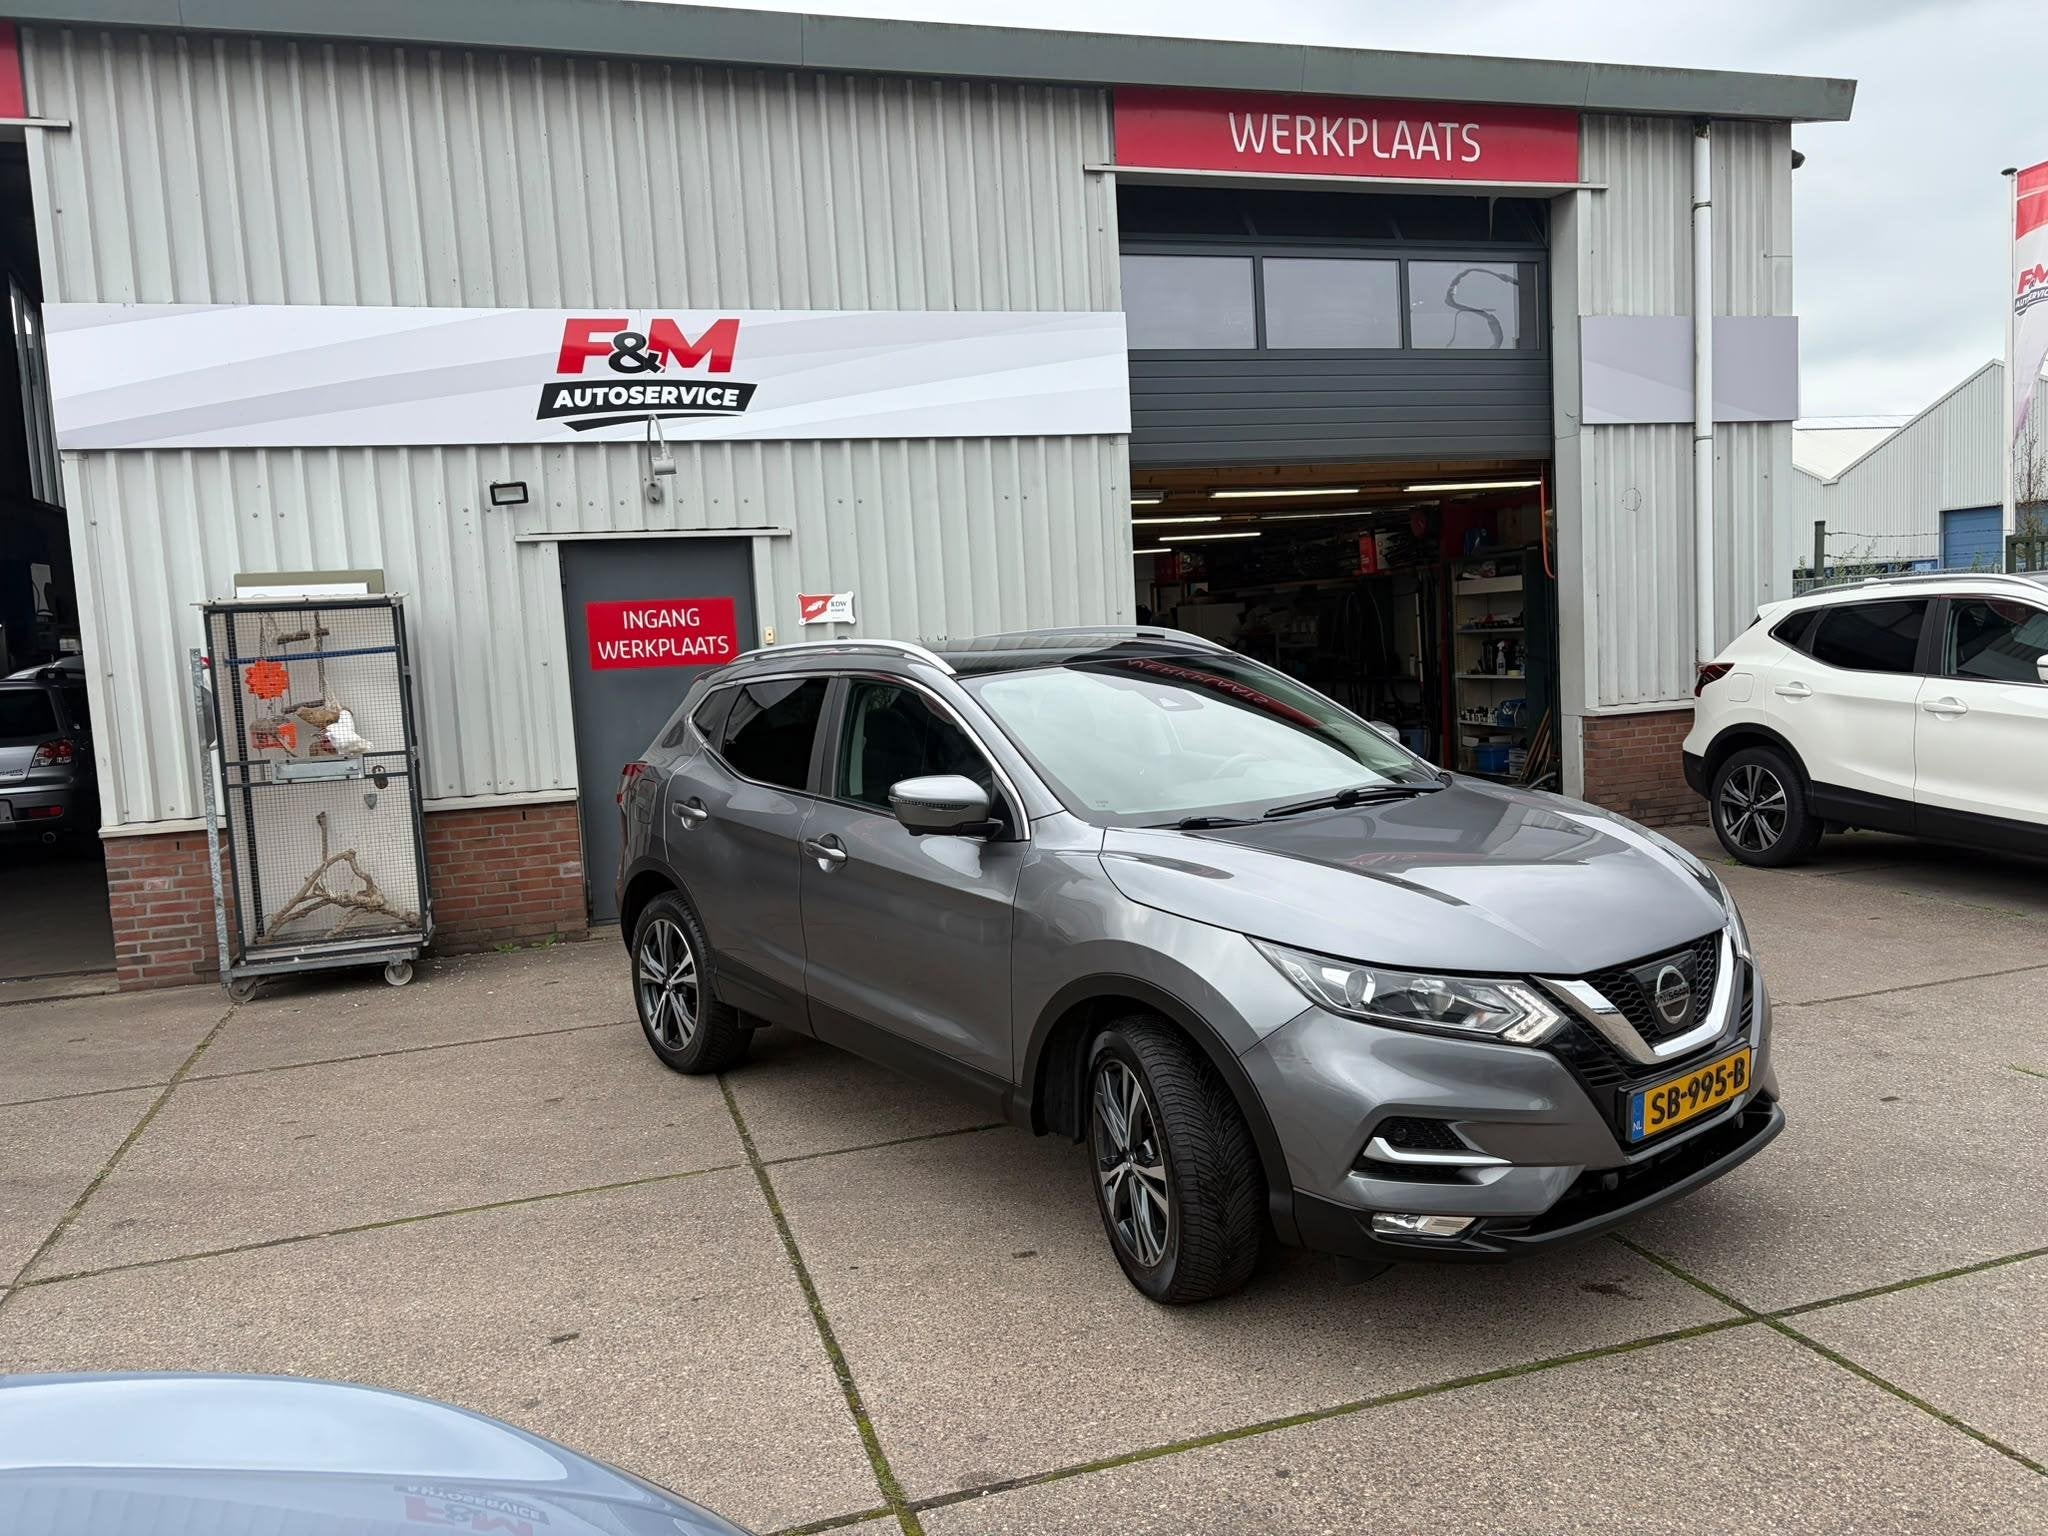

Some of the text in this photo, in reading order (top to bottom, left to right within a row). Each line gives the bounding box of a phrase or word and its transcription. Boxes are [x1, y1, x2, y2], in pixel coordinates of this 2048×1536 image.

[1228, 112, 1481, 162] WERKPLAATS
[556, 318, 740, 374] F&M
[553, 386, 740, 409] AUTOSERVICE
[623, 608, 700, 629] INGANG
[598, 636, 729, 660] WERKPLAATS
[1651, 1057, 1745, 1125] SB-995-B
[1632, 1120, 1642, 1132] NL
